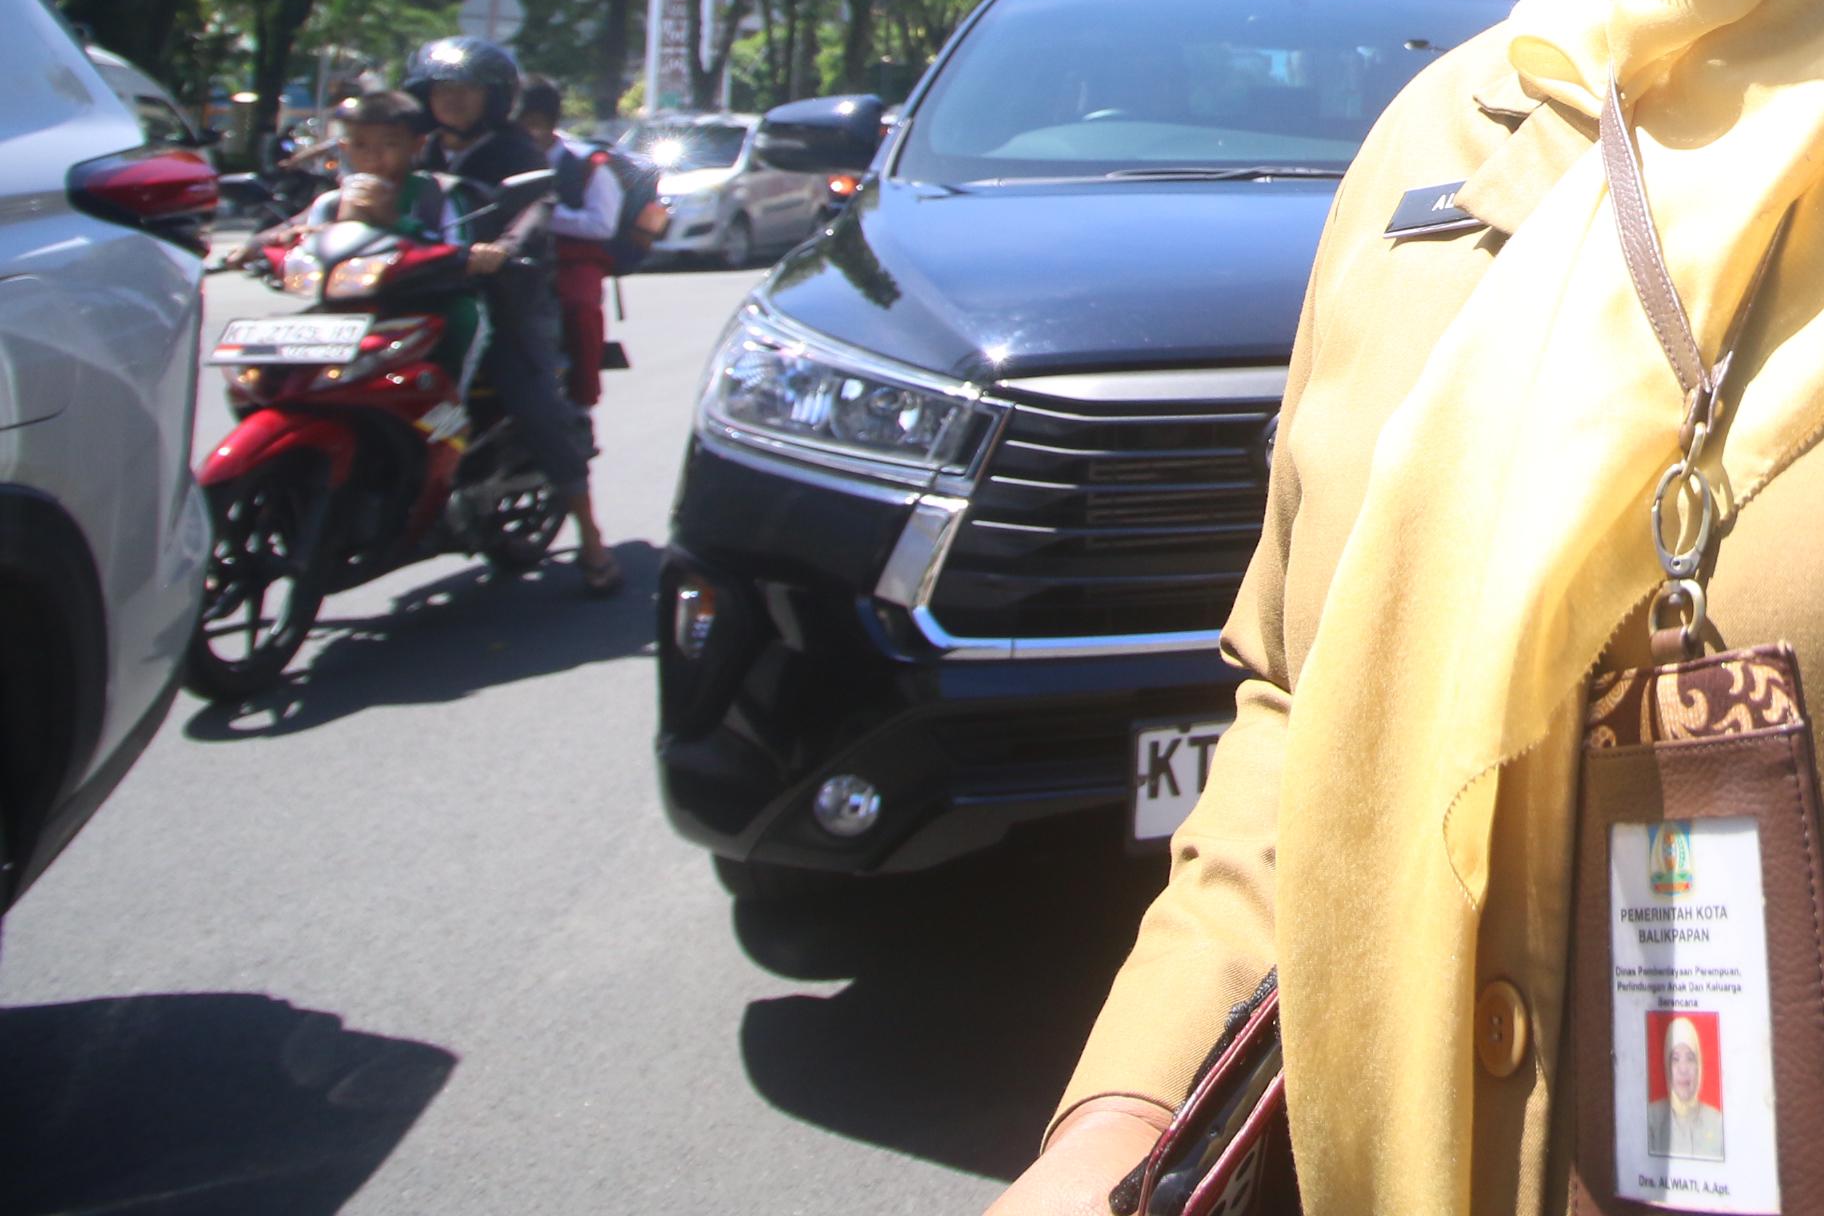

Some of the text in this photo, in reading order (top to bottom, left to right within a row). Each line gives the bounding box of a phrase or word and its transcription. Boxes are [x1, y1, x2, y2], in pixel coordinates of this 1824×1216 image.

[1147, 735, 1221, 800] KT
[1620, 905, 1728, 923] PEMERINTAH KOTA
[1638, 928, 1710, 944] BALIKPAPAN
[1615, 966, 1637, 977] Dinas
[1617, 982, 1667, 995] Perlindungan
[1667, 983, 1687, 992] Anak
[1689, 983, 1704, 992] Dan
